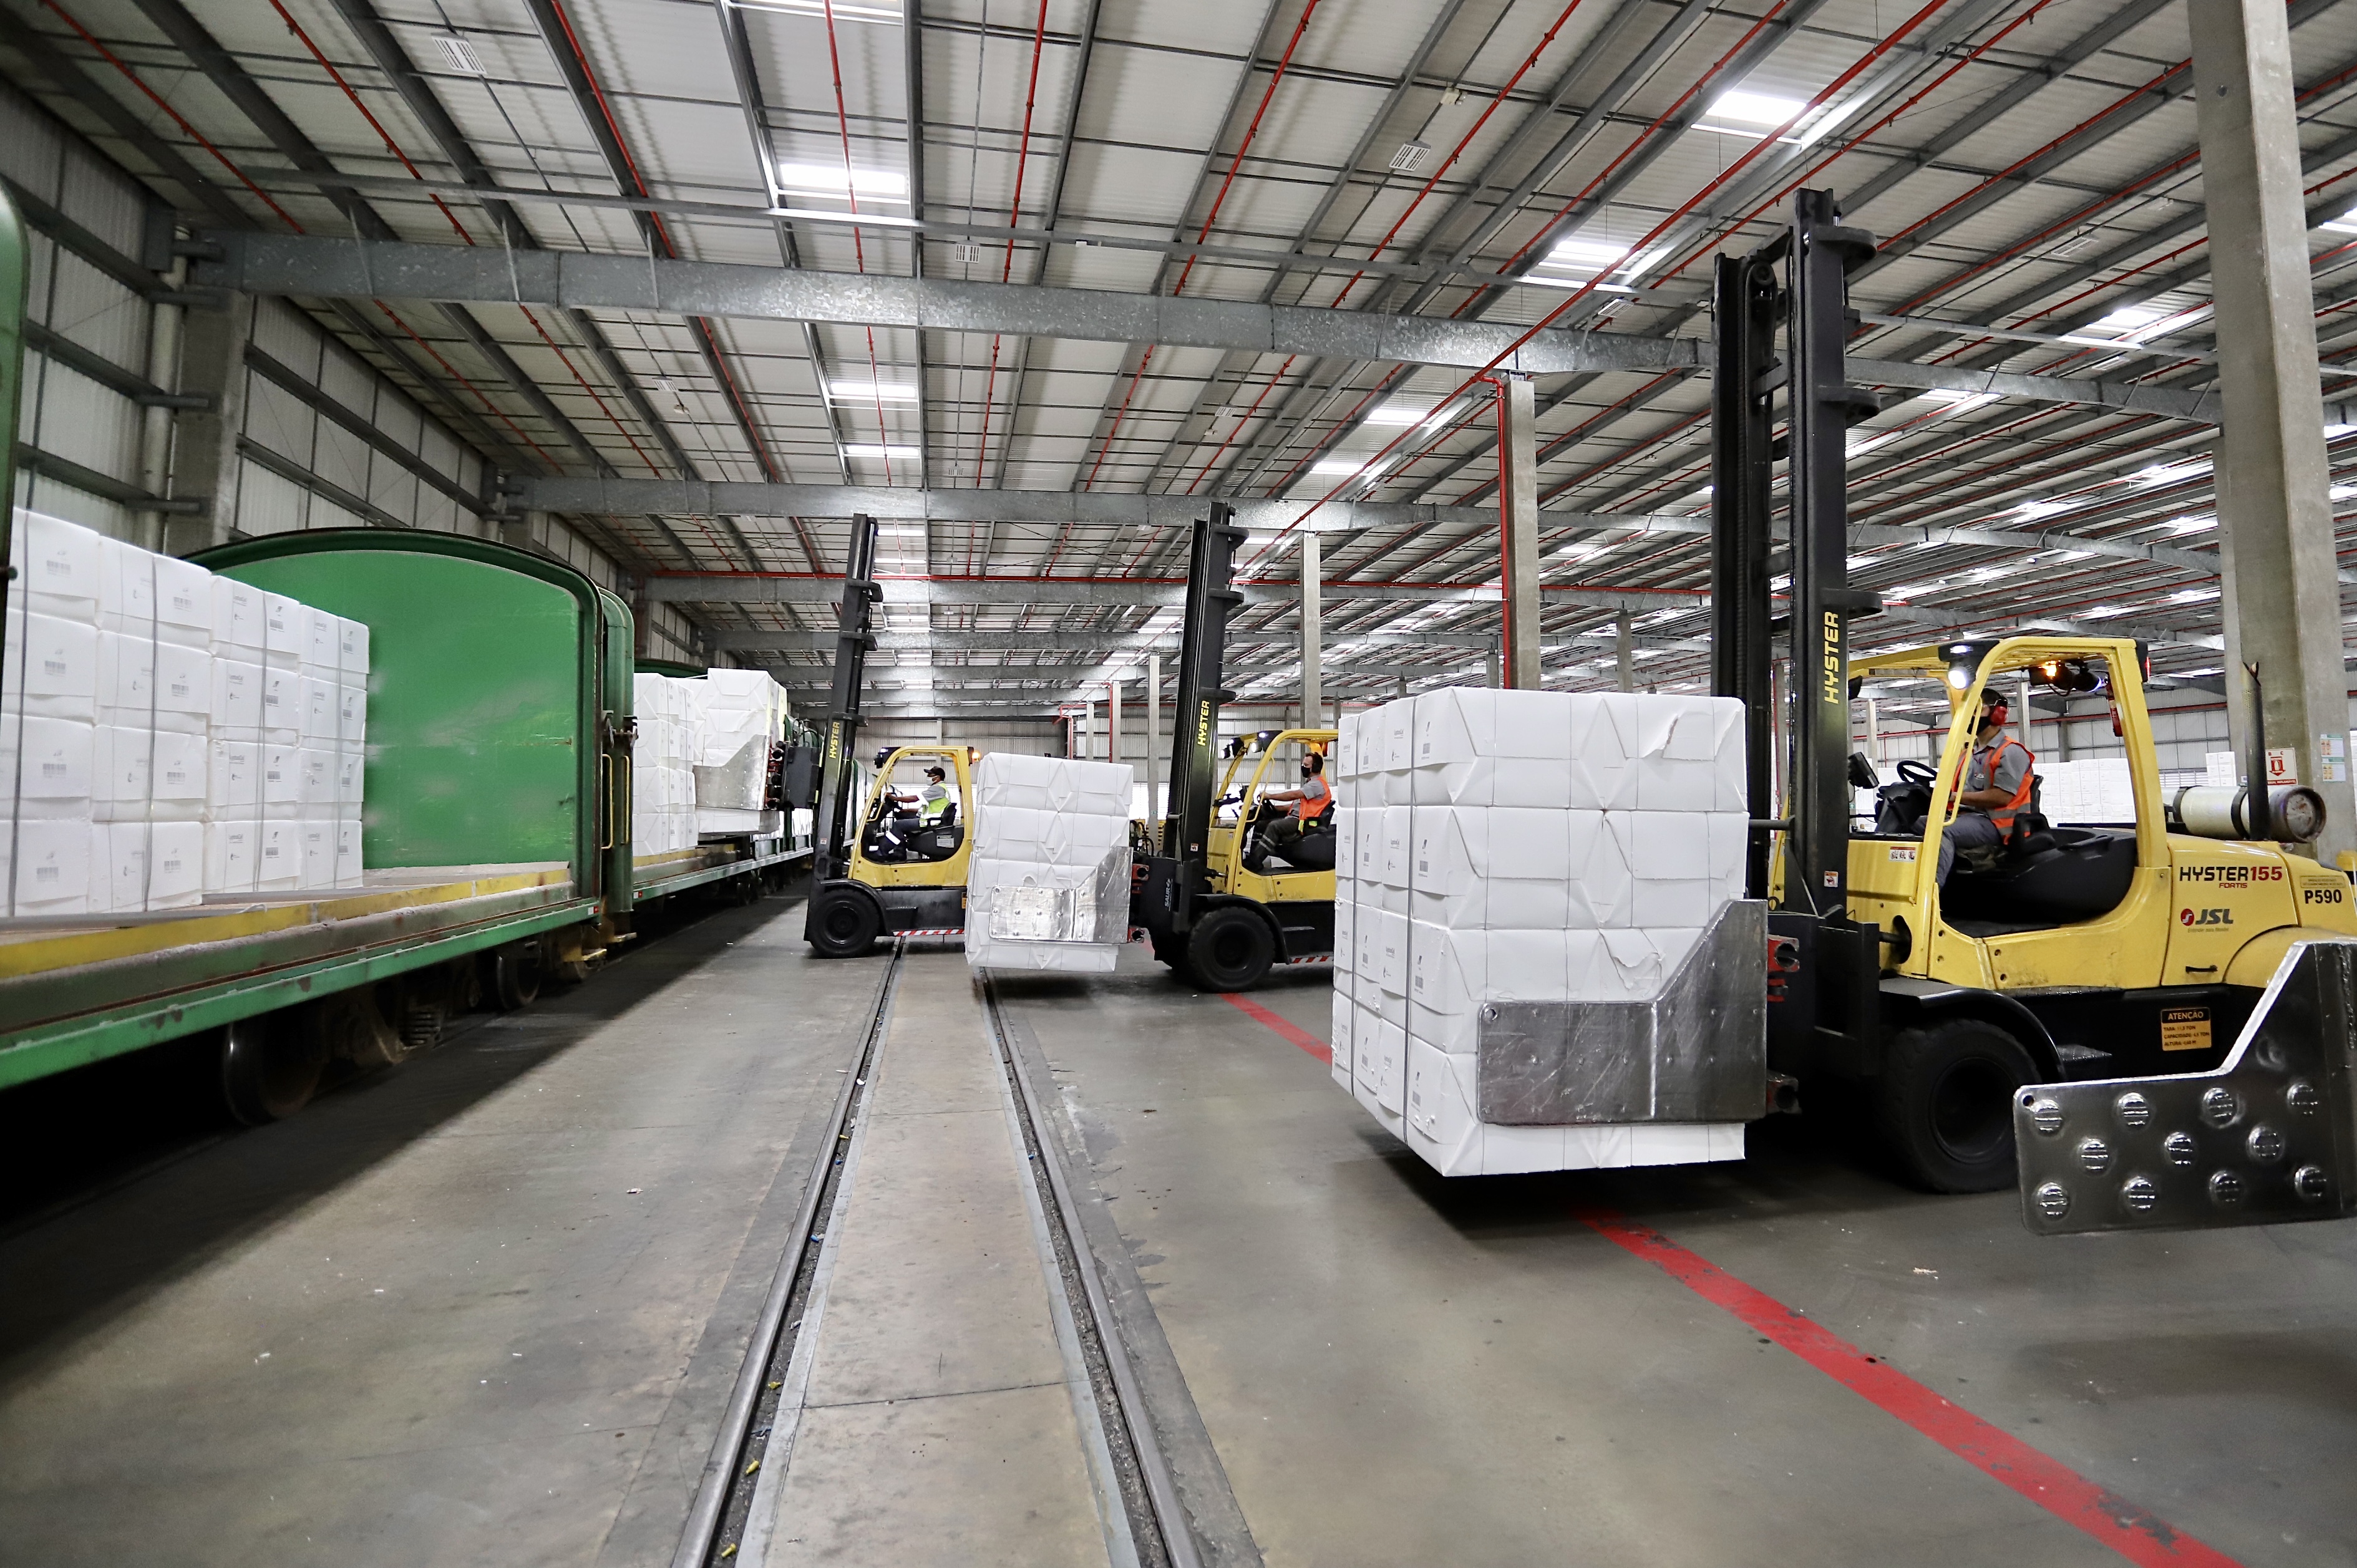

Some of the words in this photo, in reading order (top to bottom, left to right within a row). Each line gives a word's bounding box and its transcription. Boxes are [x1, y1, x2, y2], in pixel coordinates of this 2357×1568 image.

[1824, 611, 1839, 704] HYSTER
[1197, 700, 1210, 746] HYSTER
[829, 722, 840, 758] HYSTER
[2179, 866, 2248, 881] HYSTER
[2250, 866, 2283, 881] 155
[2304, 889, 2342, 904] P590
[2195, 909, 2234, 925] JSL
[2168, 1010, 2204, 1021] ATENÇÃO
